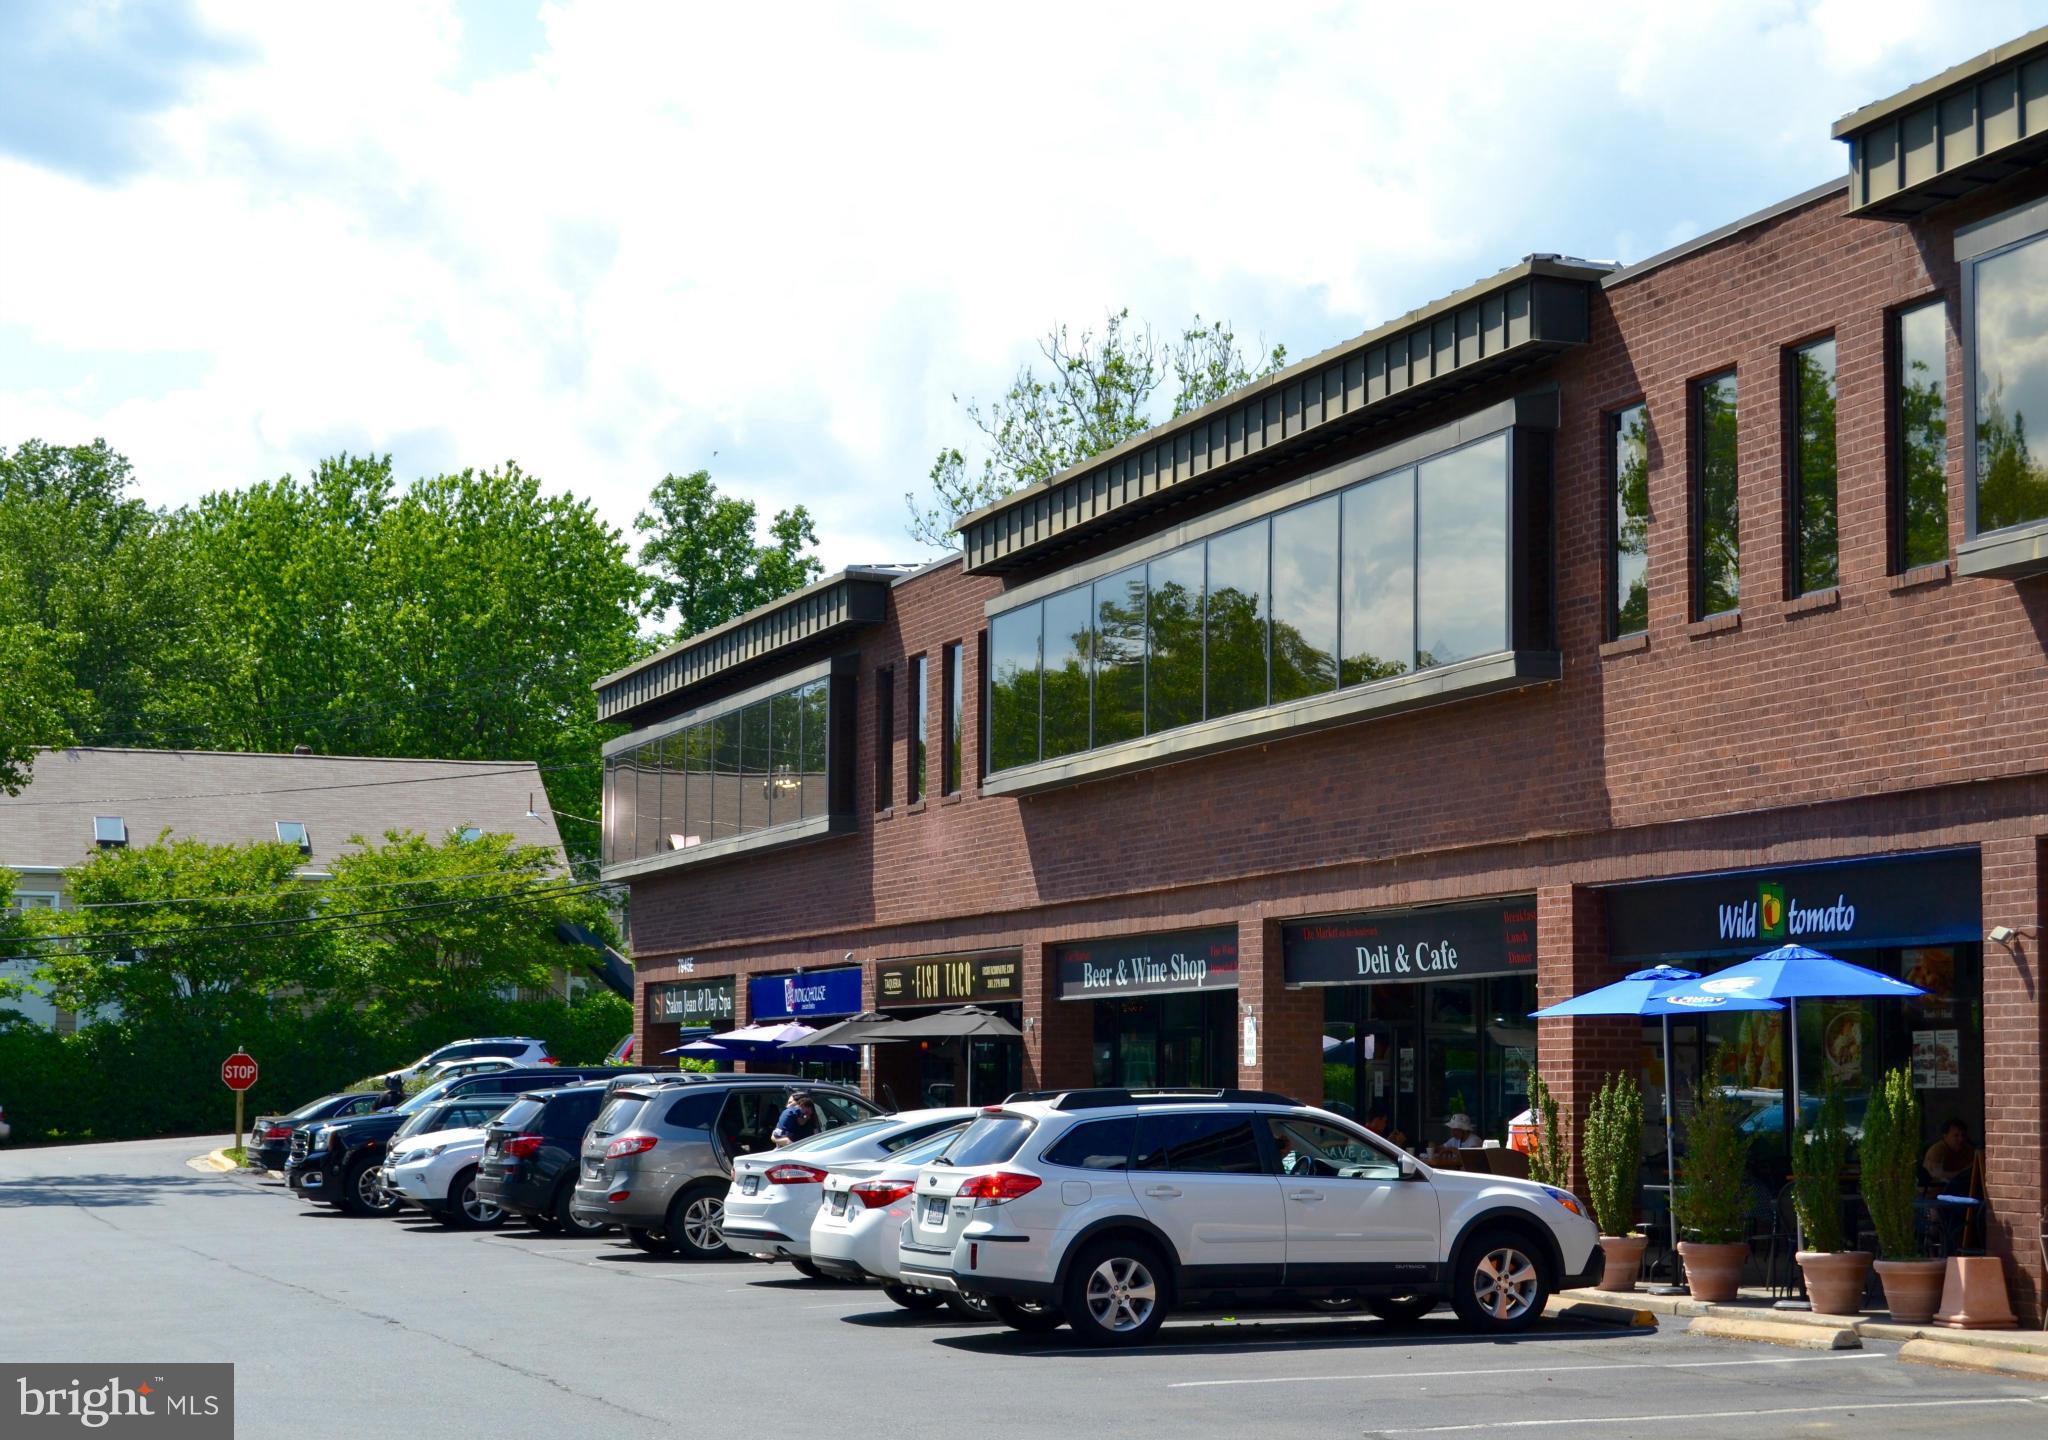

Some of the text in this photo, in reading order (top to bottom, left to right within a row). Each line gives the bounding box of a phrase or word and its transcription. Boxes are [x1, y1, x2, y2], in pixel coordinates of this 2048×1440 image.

[1719, 894, 1855, 939] Wild tomato
[1083, 962, 1112, 989] Beer
[1115, 959, 1128, 986] &
[1131, 956, 1168, 985] Wine
[1170, 953, 1206, 987] Shop
[1357, 940, 1458, 975] Deli & Cafe
[916, 961, 971, 999] FISH TACO
[666, 987, 732, 1018] Salon Jean & Day Spa
[224, 1065, 255, 1079] STOP
